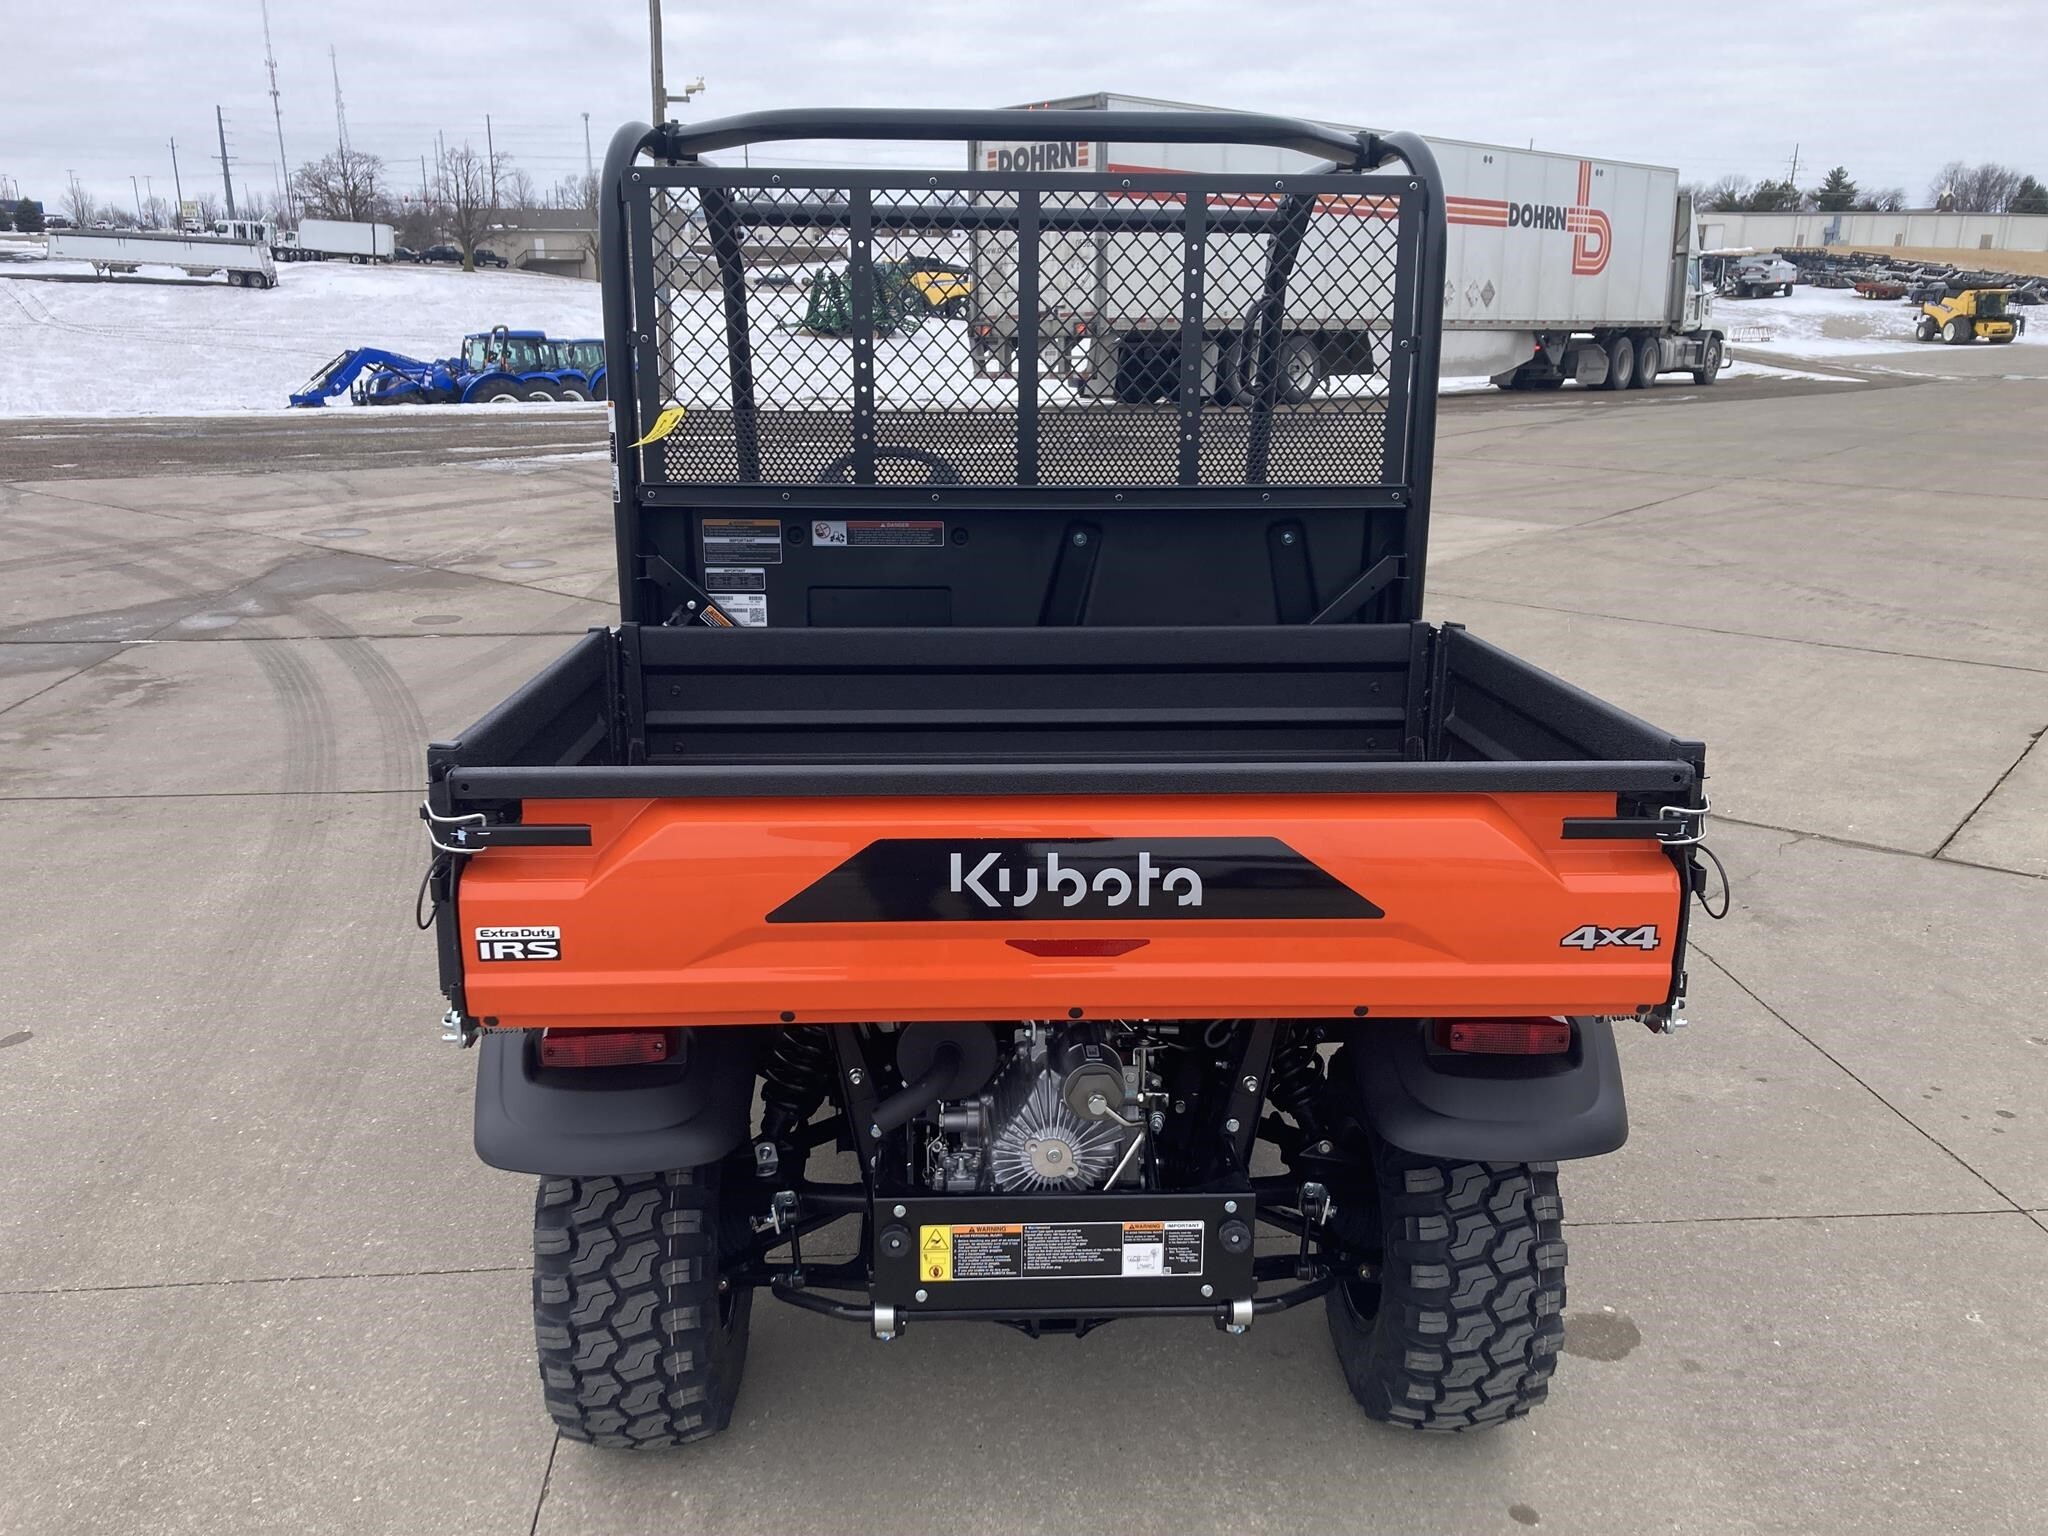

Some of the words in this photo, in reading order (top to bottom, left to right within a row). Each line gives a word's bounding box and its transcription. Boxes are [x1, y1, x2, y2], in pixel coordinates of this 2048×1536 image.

[998, 141, 1077, 171] DOHRN
[1508, 202, 1567, 230] DOHRN
[950, 852, 1203, 907] Kubota
[480, 942, 558, 960] IRS
[1560, 925, 1661, 951] 4x4
